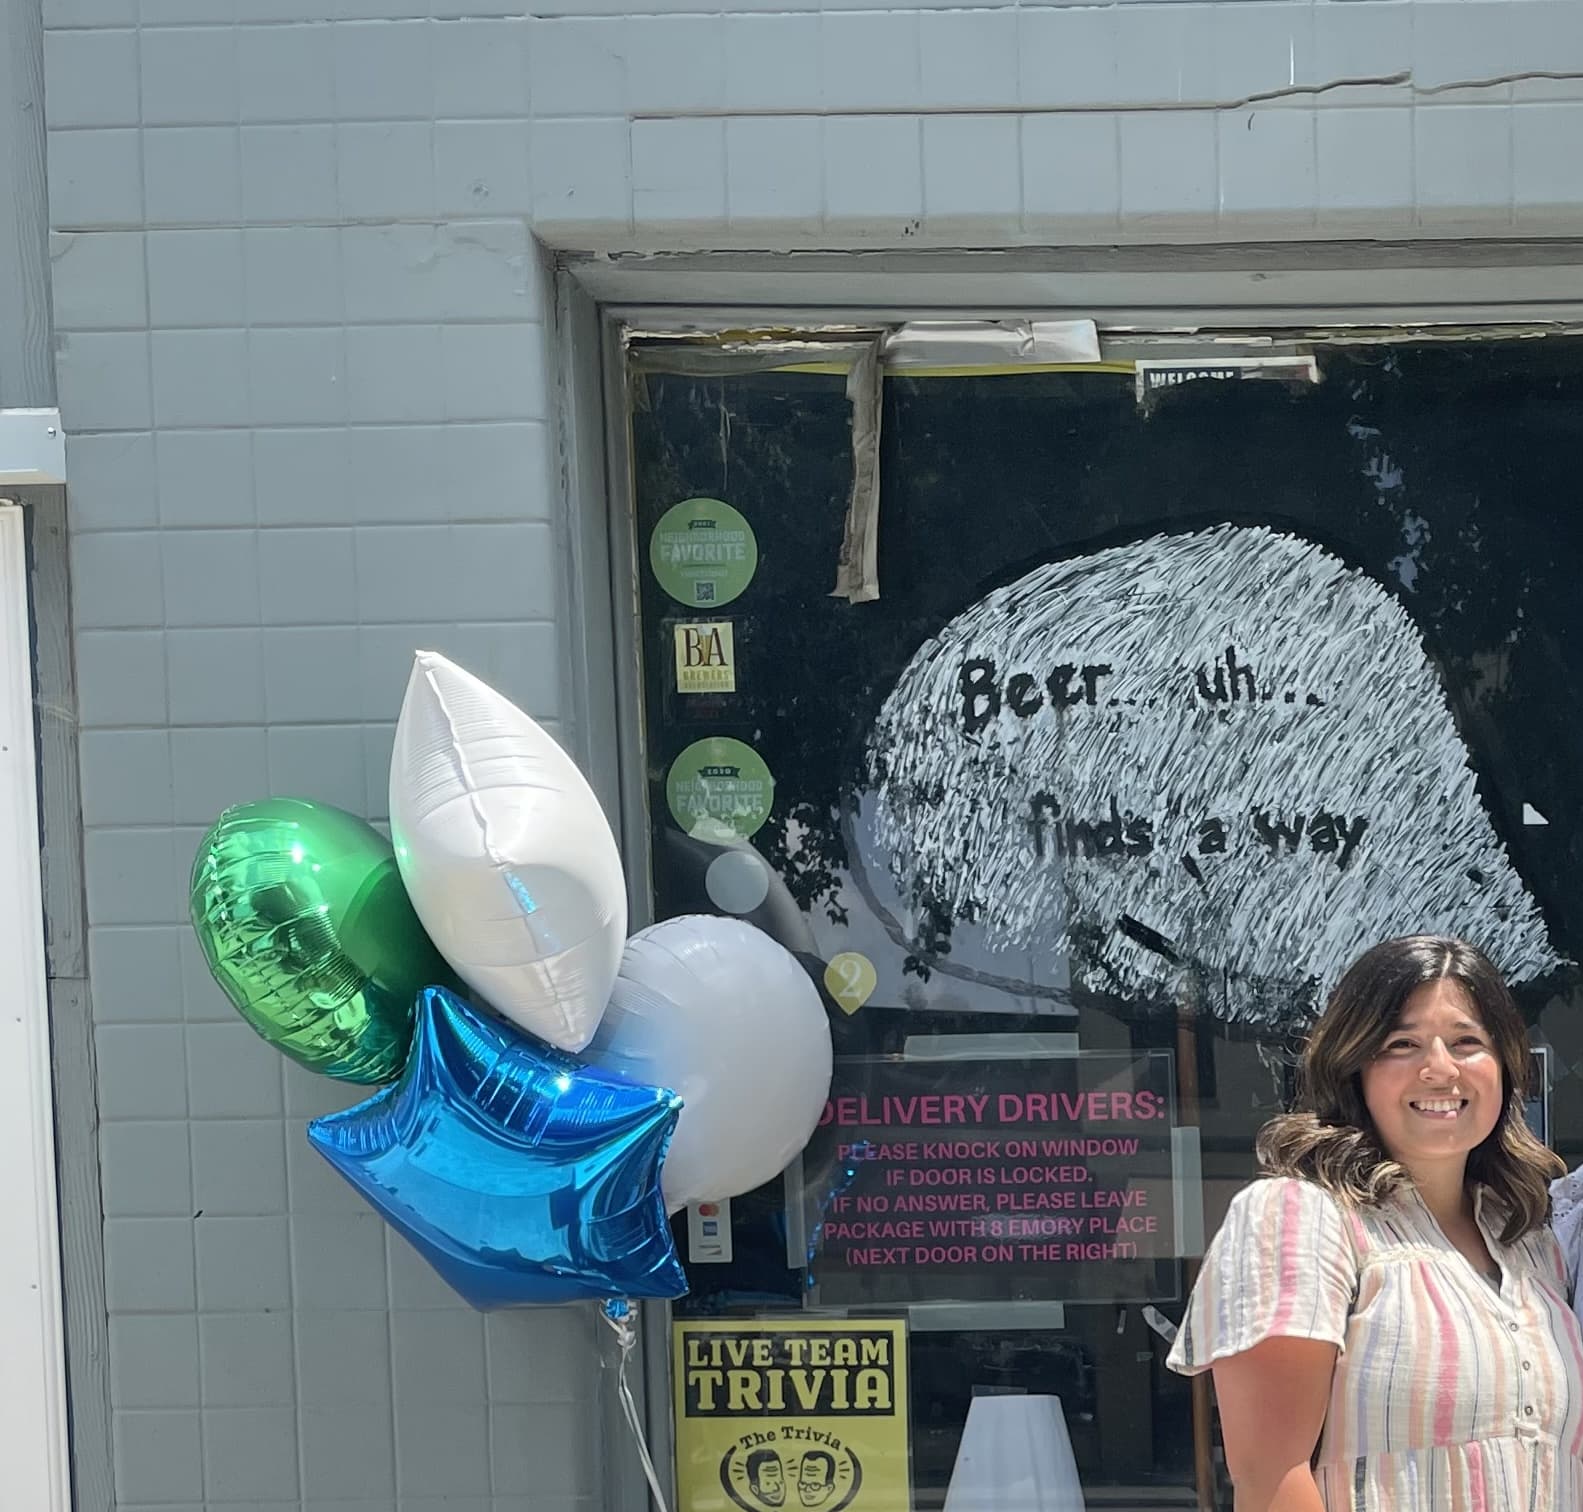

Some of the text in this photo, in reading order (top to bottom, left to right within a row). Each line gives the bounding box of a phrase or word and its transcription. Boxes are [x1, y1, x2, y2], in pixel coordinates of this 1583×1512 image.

[661, 543, 746, 562] FAVORITE
[1200, 815, 1228, 855] a
[1251, 807, 1369, 870] way
[999, 1091, 1165, 1122] DRIVERS:
[838, 1138, 1139, 1161] PLEASE KNOCK ON WINDOW
[886, 1165, 1093, 1186] IF DOOR IS LOCKED.
[832, 1190, 1147, 1213] IF NO ANSWER, PLEASE LEAVE
[824, 1216, 1157, 1240] PACKAGE WITH 8 EMORY PLACE
[846, 1241, 1137, 1266] (NEXT DOOR ON THE RIGHT)
[688, 1338, 889, 1367] LIVE TEAM
[688, 1368, 892, 1410] TRIVIA
[739, 1426, 842, 1450] The Trivia
